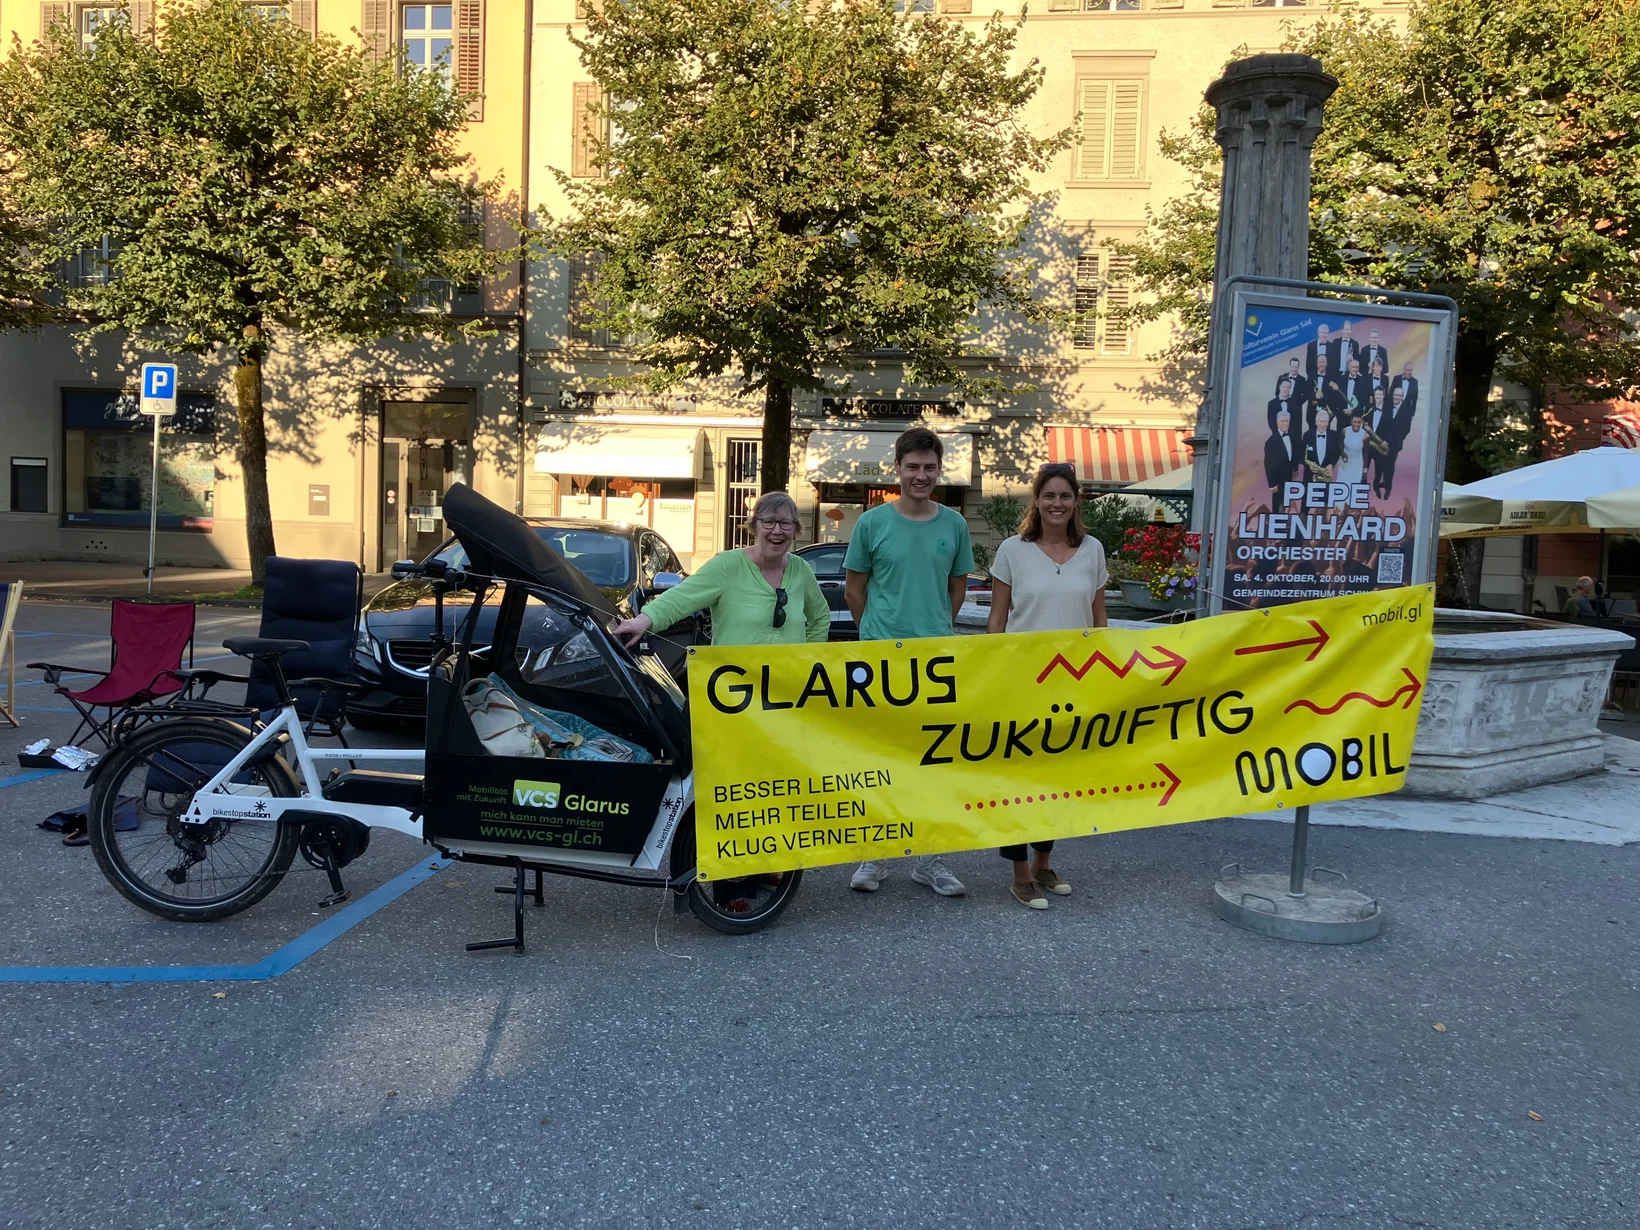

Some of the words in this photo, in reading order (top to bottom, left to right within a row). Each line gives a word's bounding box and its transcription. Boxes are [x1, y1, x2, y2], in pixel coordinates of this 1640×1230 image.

[1280, 325, 1299, 336] Glarus
[1300, 318, 1312, 329] Süd
[152, 370, 168, 395] P
[1283, 481, 1371, 509] PEPE
[1238, 512, 1407, 542] LIENHARD
[1236, 545, 1347, 561] ORCHESTER
[1233, 573, 1251, 582] SA.
[1253, 574, 1264, 582] 4.
[1266, 574, 1317, 585] OKTOBER,
[1319, 574, 1346, 583] 20.00
[1348, 575, 1370, 583] UHR
[1232, 588, 1336, 598] GEMEINDEZENTRUM
[1361, 602, 1422, 627] mobil.gl
[706, 655, 957, 715] GLARUS
[919, 690, 1254, 767] ZUKÜNFTIG
[1234, 732, 1405, 796] MOBIL
[456, 793, 472, 802] mit
[473, 794, 508, 804] Zukunft
[468, 784, 509, 796] Mobilität
[714, 779, 801, 804] BESSER
[808, 769, 892, 795] LENKEN
[212, 808, 271, 819] bikestopstation
[515, 788, 558, 809] VCS
[564, 794, 630, 815] Glarus
[481, 809, 507, 820] mich
[509, 811, 537, 822] kann
[539, 815, 563, 825] man
[566, 816, 604, 828] mieten
[656, 796, 683, 850] bikestopstation
[715, 806, 781, 831] MEHR
[786, 799, 866, 822] TEILEN
[480, 825, 602, 847] www.vcs-gl.ch
[716, 836, 778, 860] KLUG
[782, 821, 914, 850] VERNETZEN
